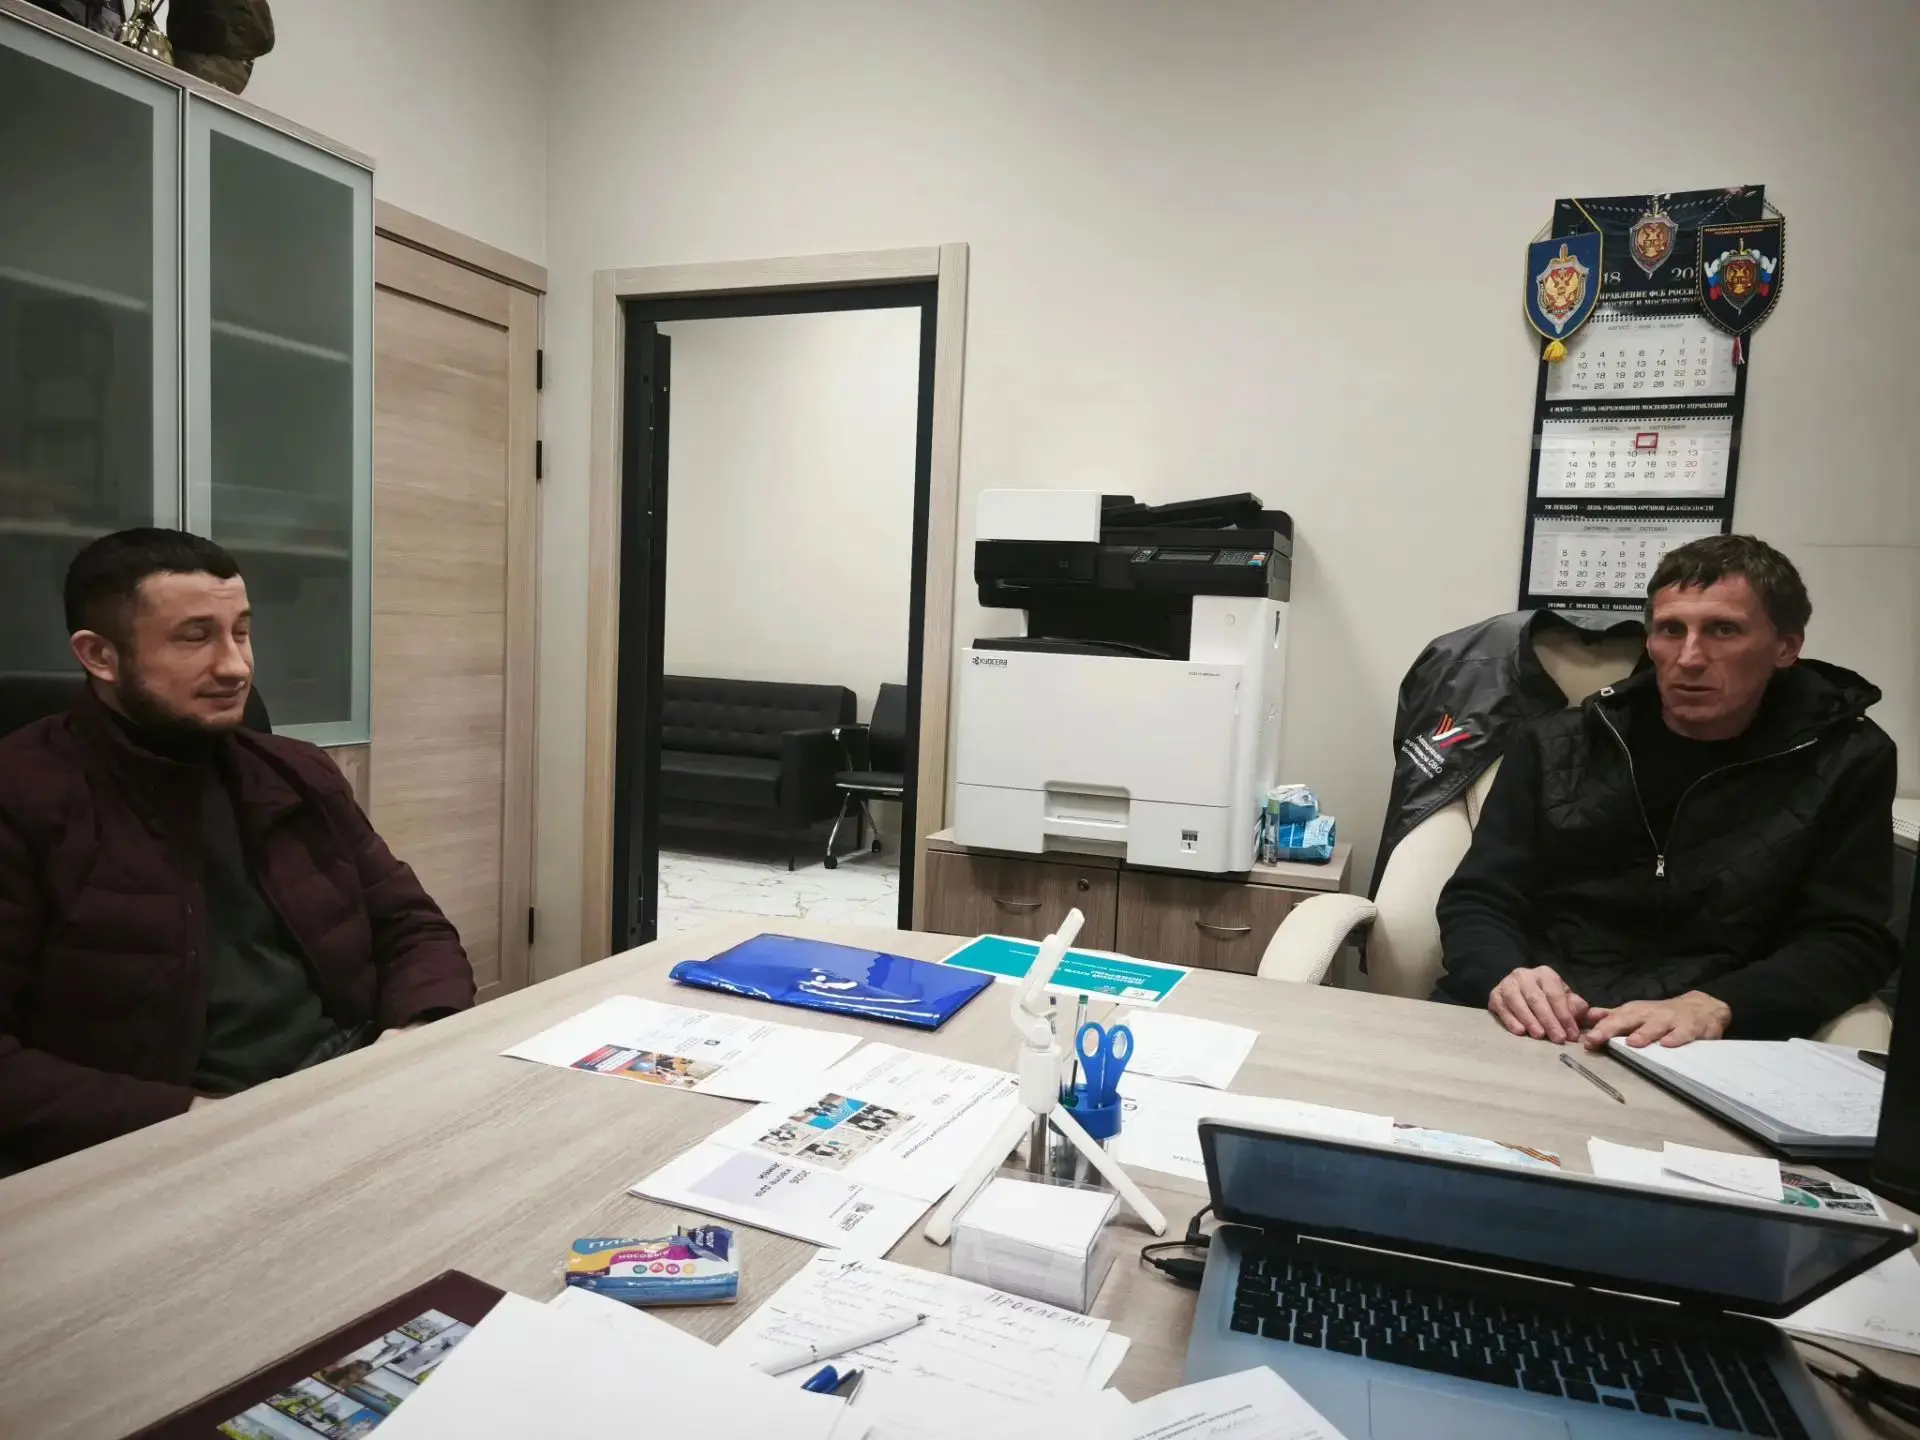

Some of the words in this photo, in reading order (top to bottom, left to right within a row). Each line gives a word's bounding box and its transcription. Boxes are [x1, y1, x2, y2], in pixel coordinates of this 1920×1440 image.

[1603, 272, 1621, 284] 18
[1649, 289, 1666, 297] ФСБ
[1673, 380, 1685, 388] 29
[1627, 449, 1639, 457] 10
[980, 658, 1008, 666] KYOCERA
[1428, 760, 1442, 774] СВО
[983, 1290, 1093, 1328] ПРОБЛЕМЫ
